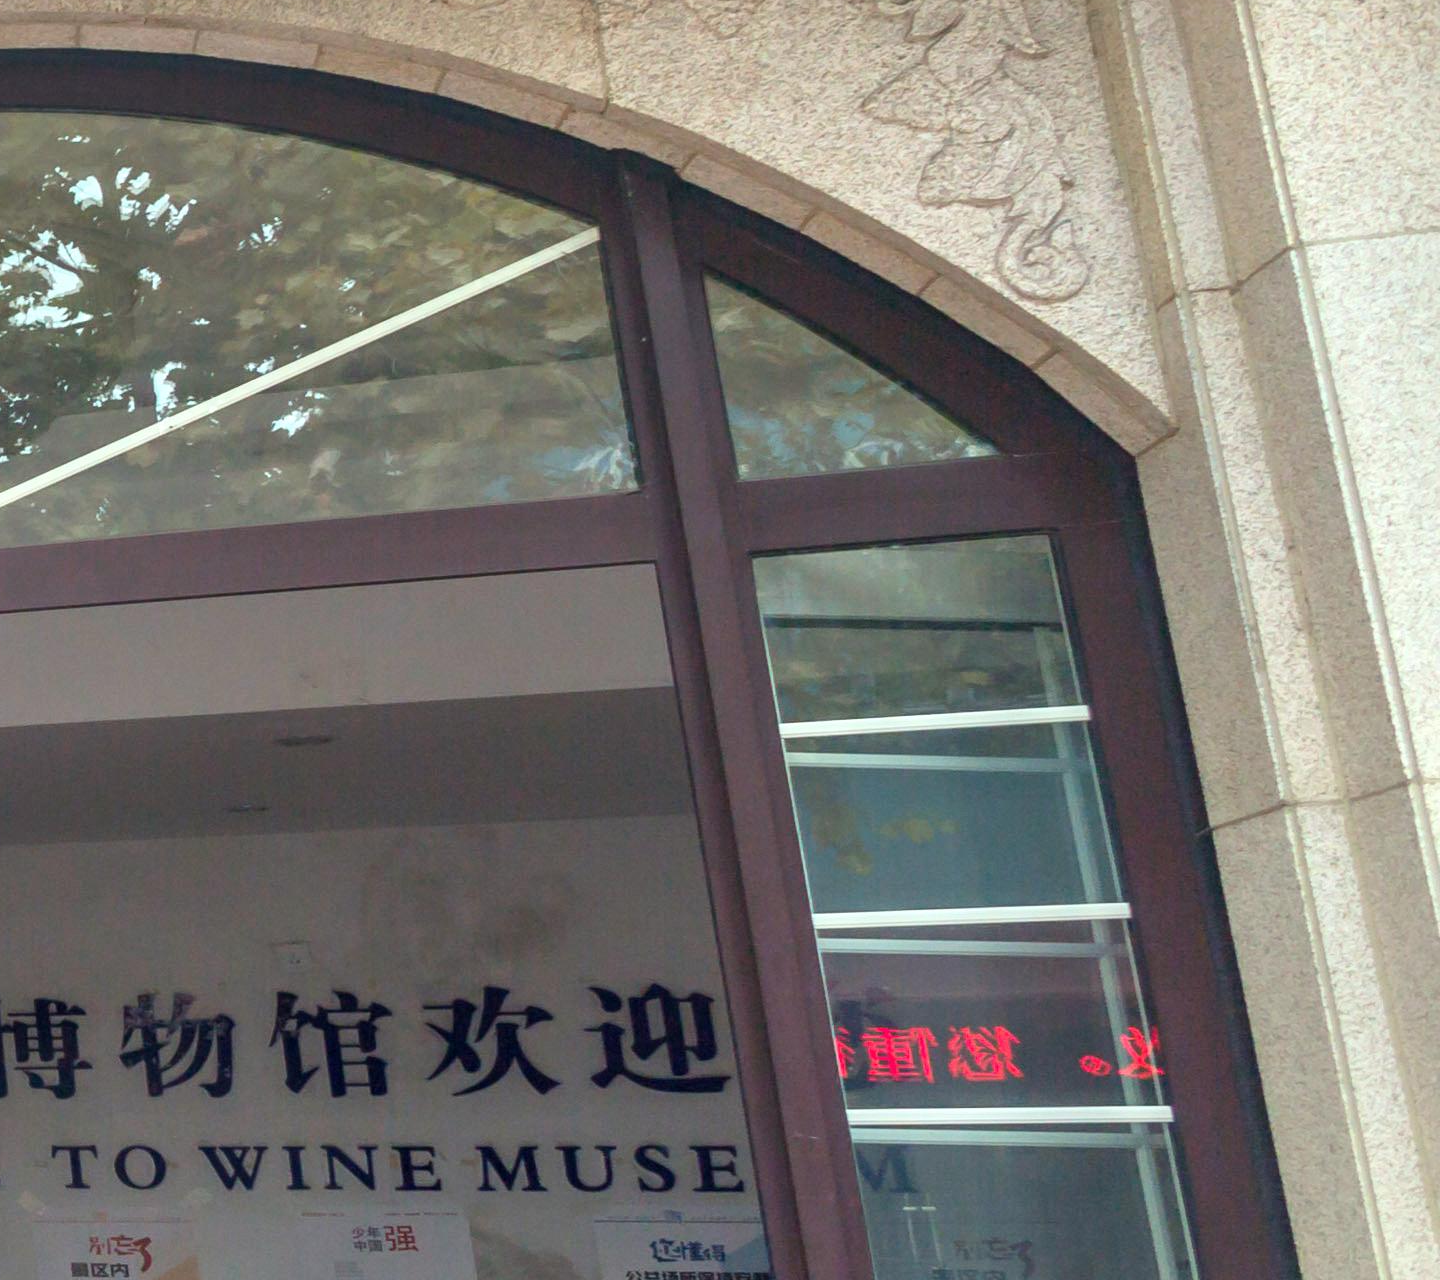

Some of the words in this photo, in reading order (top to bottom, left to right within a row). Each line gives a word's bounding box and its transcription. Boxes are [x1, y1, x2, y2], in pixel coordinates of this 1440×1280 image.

[51, 1144, 168, 1190] TO
[197, 1144, 442, 1192] WINE
[382, 1224, 420, 1253] 强
